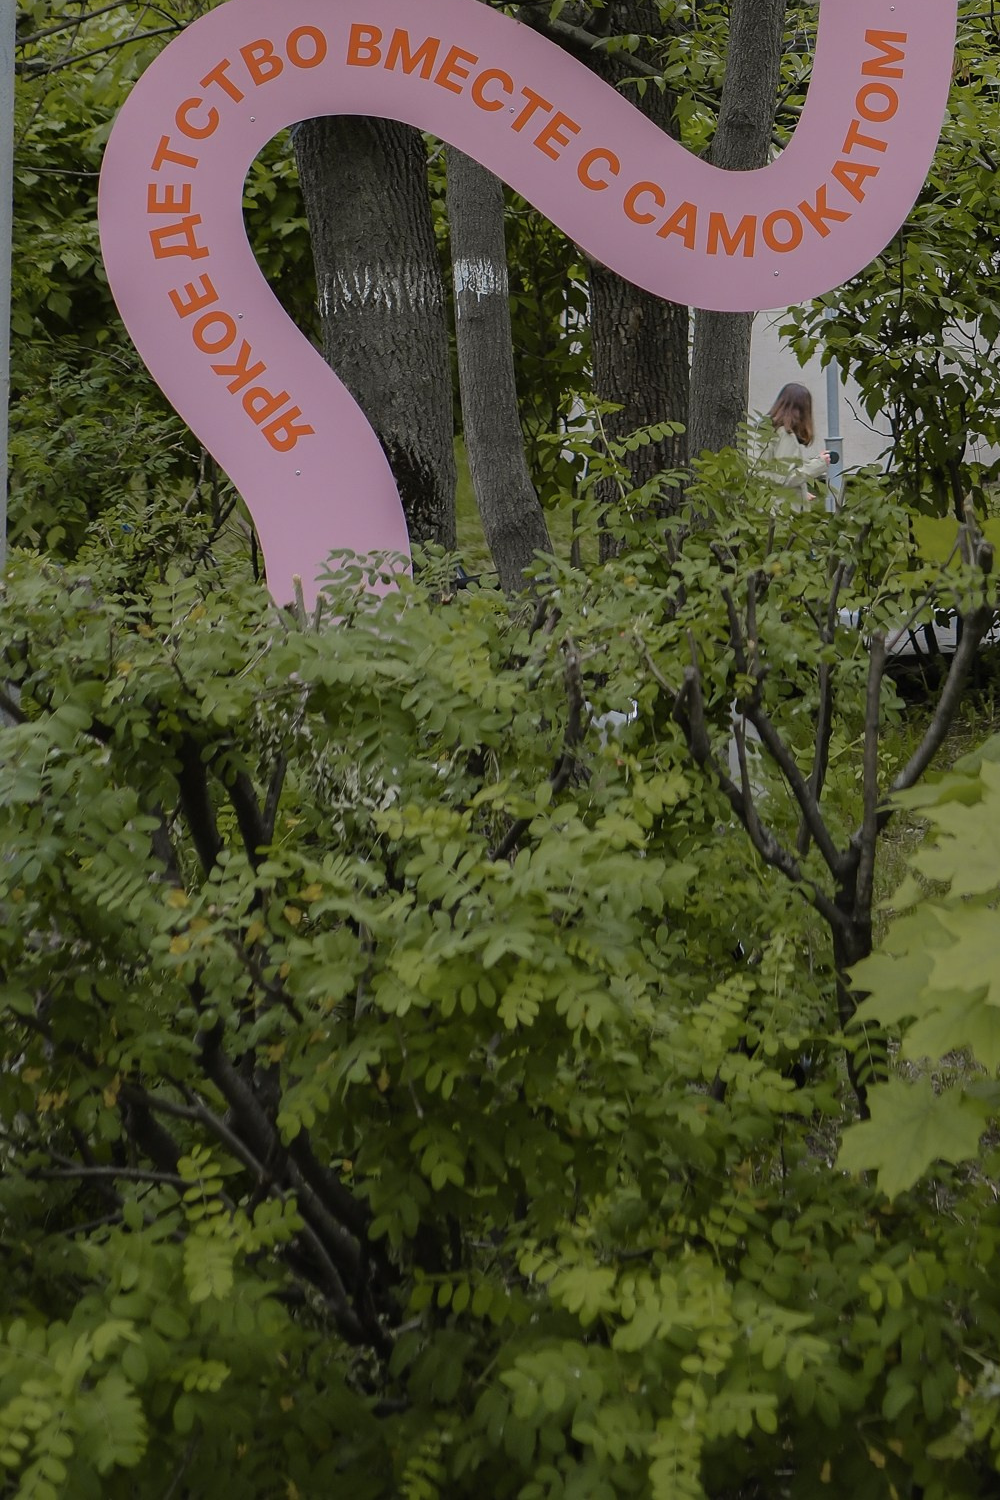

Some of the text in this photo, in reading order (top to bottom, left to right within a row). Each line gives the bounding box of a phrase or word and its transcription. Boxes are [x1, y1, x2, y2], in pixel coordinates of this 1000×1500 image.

[146, 22, 908, 453] ЯРКОЕ ДЕТСТВО ВМЕСТЕ С САМОКАТОМ
